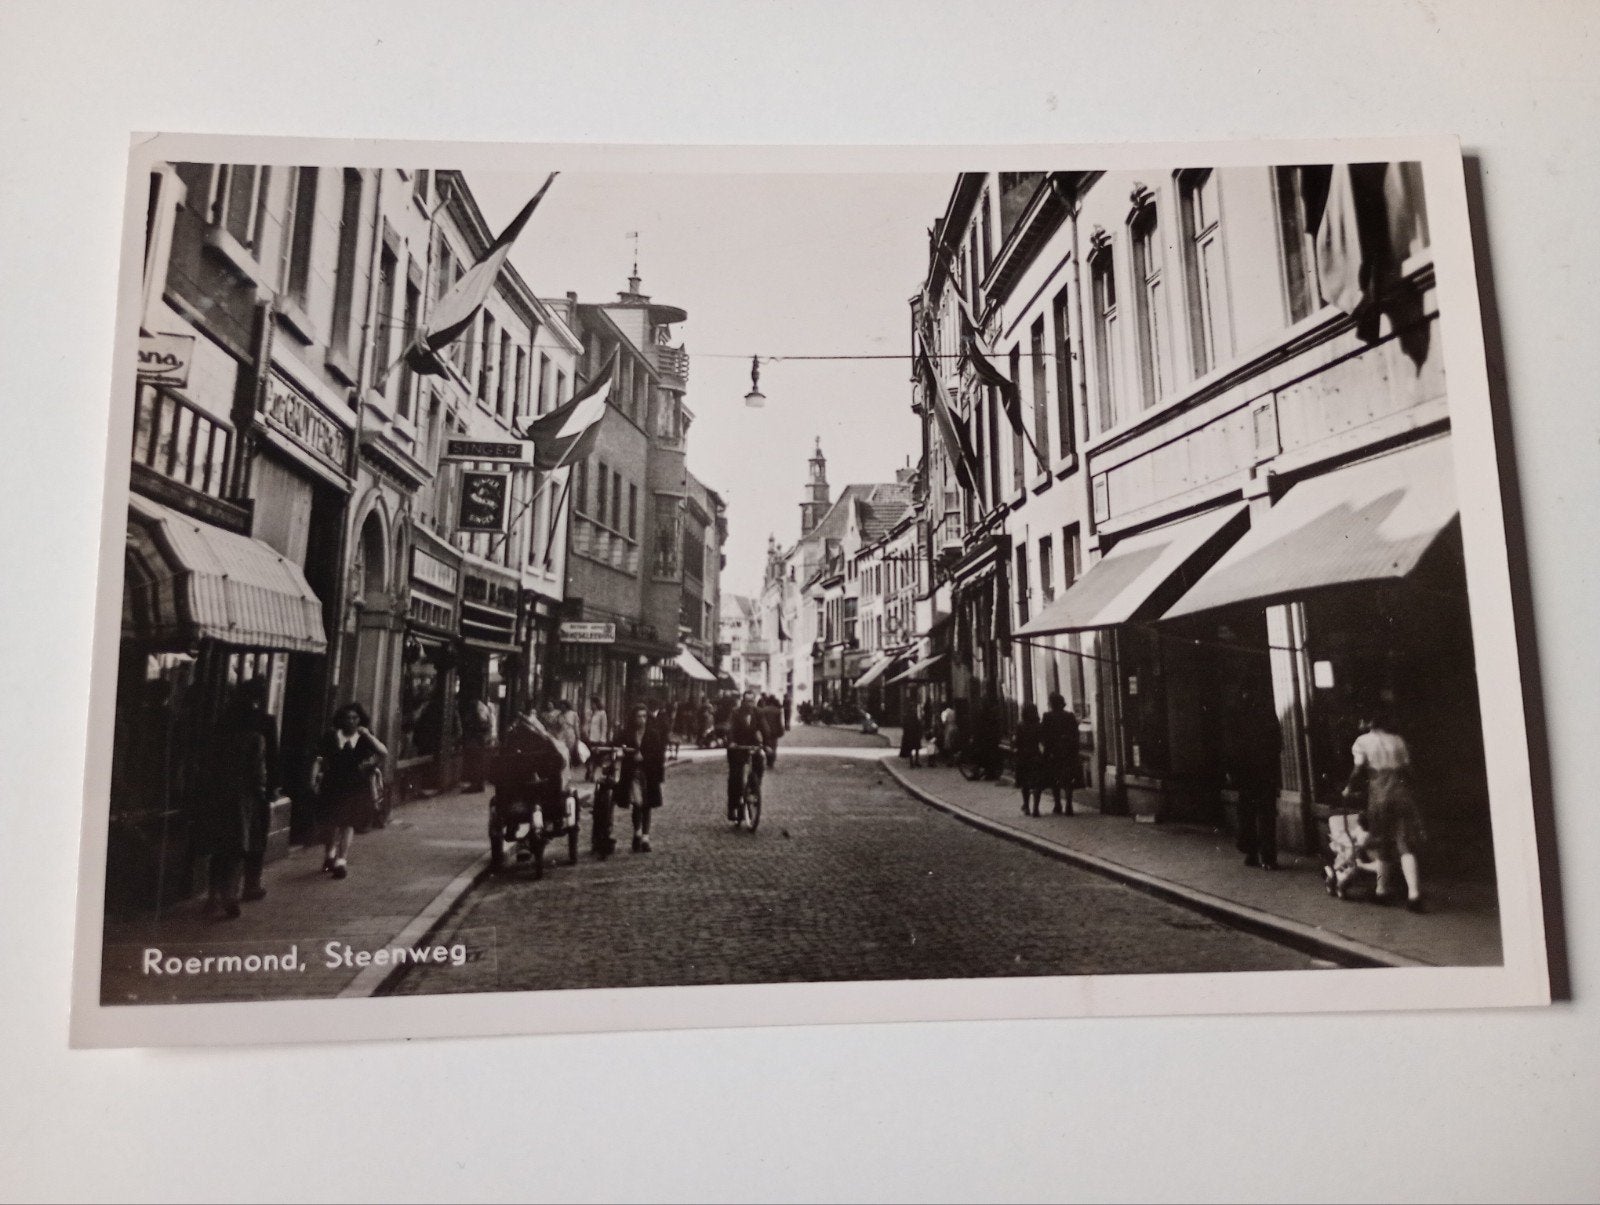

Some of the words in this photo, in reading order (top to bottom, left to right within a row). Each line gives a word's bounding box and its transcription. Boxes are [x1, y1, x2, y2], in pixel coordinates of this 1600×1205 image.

[453, 442, 517, 456] SINGER
[142, 945, 306, 974] Roermond,
[325, 940, 466, 967] Steenweg
